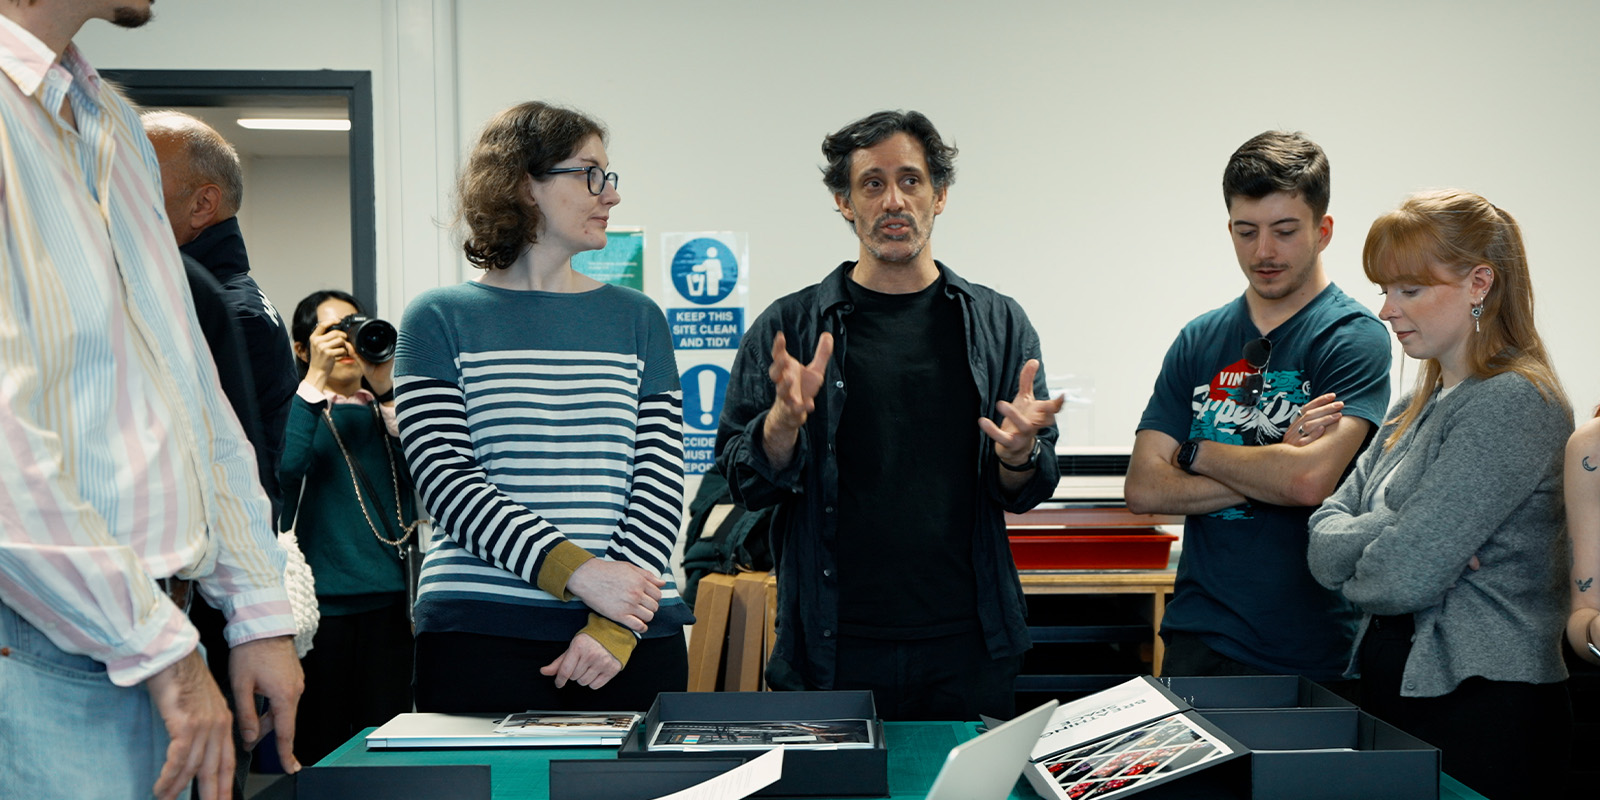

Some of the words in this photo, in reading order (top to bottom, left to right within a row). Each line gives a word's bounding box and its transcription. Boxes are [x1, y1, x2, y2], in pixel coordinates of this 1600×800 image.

[676, 312, 706, 321] KEEP
[708, 311, 733, 321] THIS
[673, 324, 697, 335] SITE
[699, 324, 737, 334] CLEAN
[679, 337, 703, 347] AND
[705, 337, 731, 347] TIDY
[683, 437, 715, 447] CCIDE
[1060, 704, 1118, 726] SPACE
